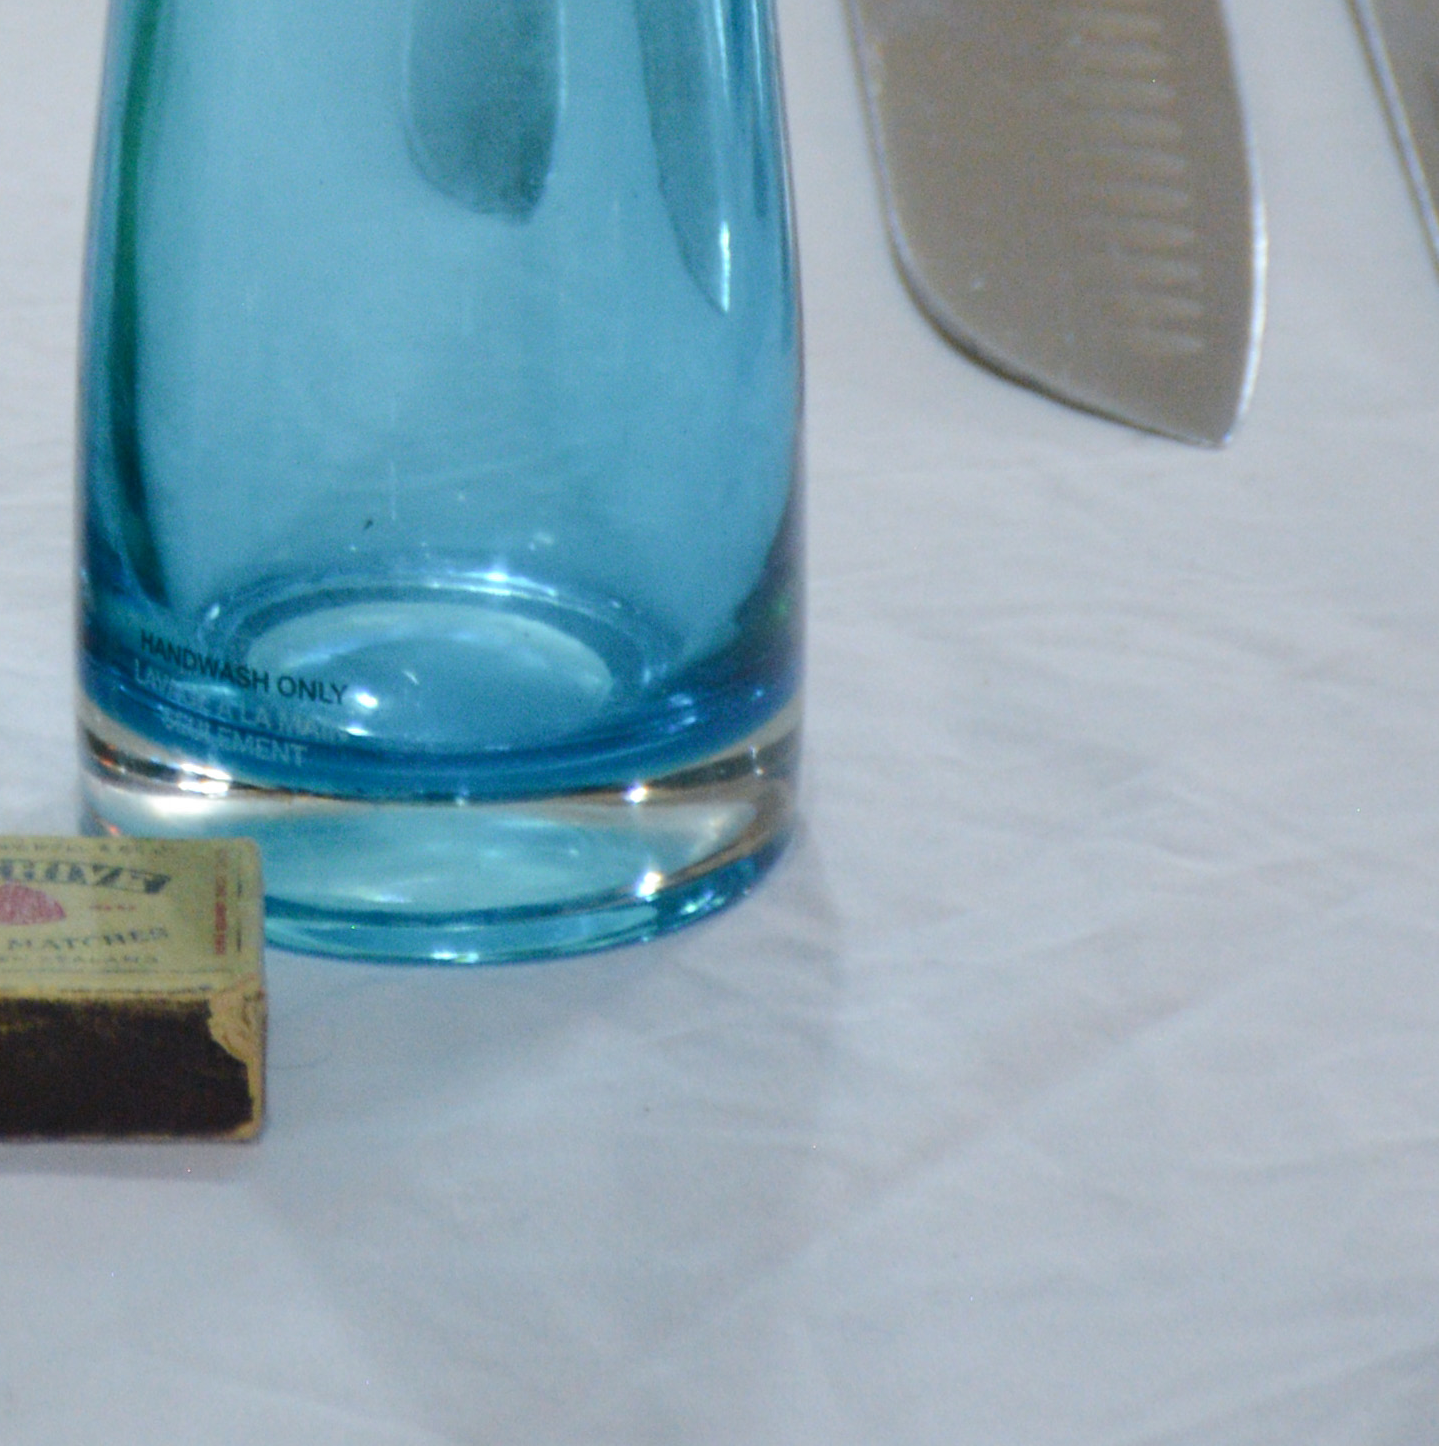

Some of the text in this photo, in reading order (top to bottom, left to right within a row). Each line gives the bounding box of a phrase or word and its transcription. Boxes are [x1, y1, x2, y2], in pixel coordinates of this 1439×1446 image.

[140, 628, 349, 705] HANDWASH ONLY
[8, 926, 169, 951] MATCHES
